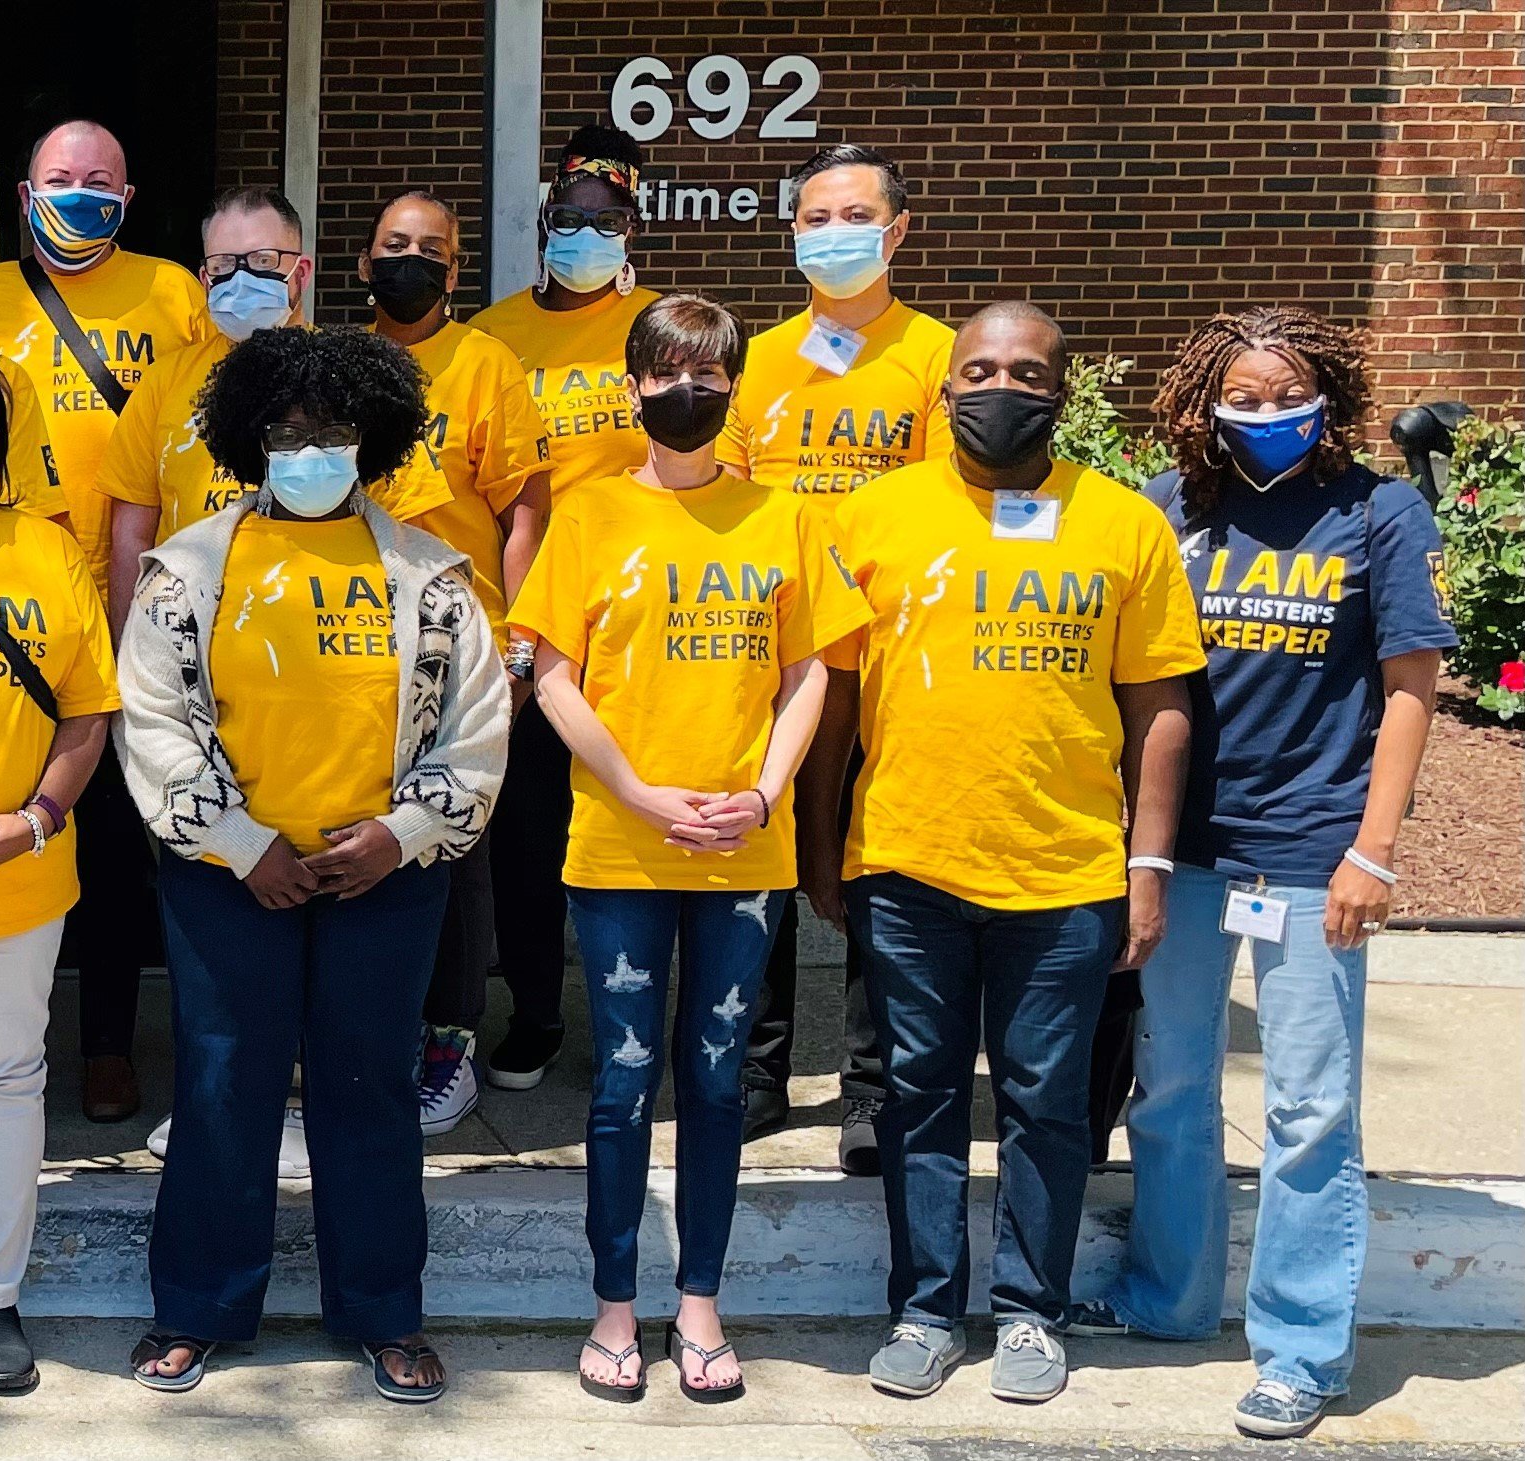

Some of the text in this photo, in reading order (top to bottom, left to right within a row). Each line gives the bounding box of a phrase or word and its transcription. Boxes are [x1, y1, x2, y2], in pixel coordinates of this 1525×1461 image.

[611, 55, 821, 141] 692
[53, 334, 62, 367] I
[53, 372, 79, 386] MY
[534, 368, 545, 397] I
[53, 390, 113, 412] KEE
[800, 408, 915, 450] I AM
[798, 452, 907, 467] MY SISTER'S
[792, 472, 882, 494] KEEP
[666, 561, 784, 605] I AM
[1205, 549, 1345, 603] I AM
[309, 576, 391, 609] I A
[975, 570, 1105, 619] I AM
[316, 614, 392, 627] MY SIS
[668, 609, 774, 629] MY SISTER'S
[1201, 595, 1336, 624] MY SISTER'S
[974, 621, 1095, 641] MY SISTER'S
[1201, 618, 1331, 654] KEEPER
[666, 633, 771, 661] KEEPER
[972, 645, 1094, 673] KEEPER
